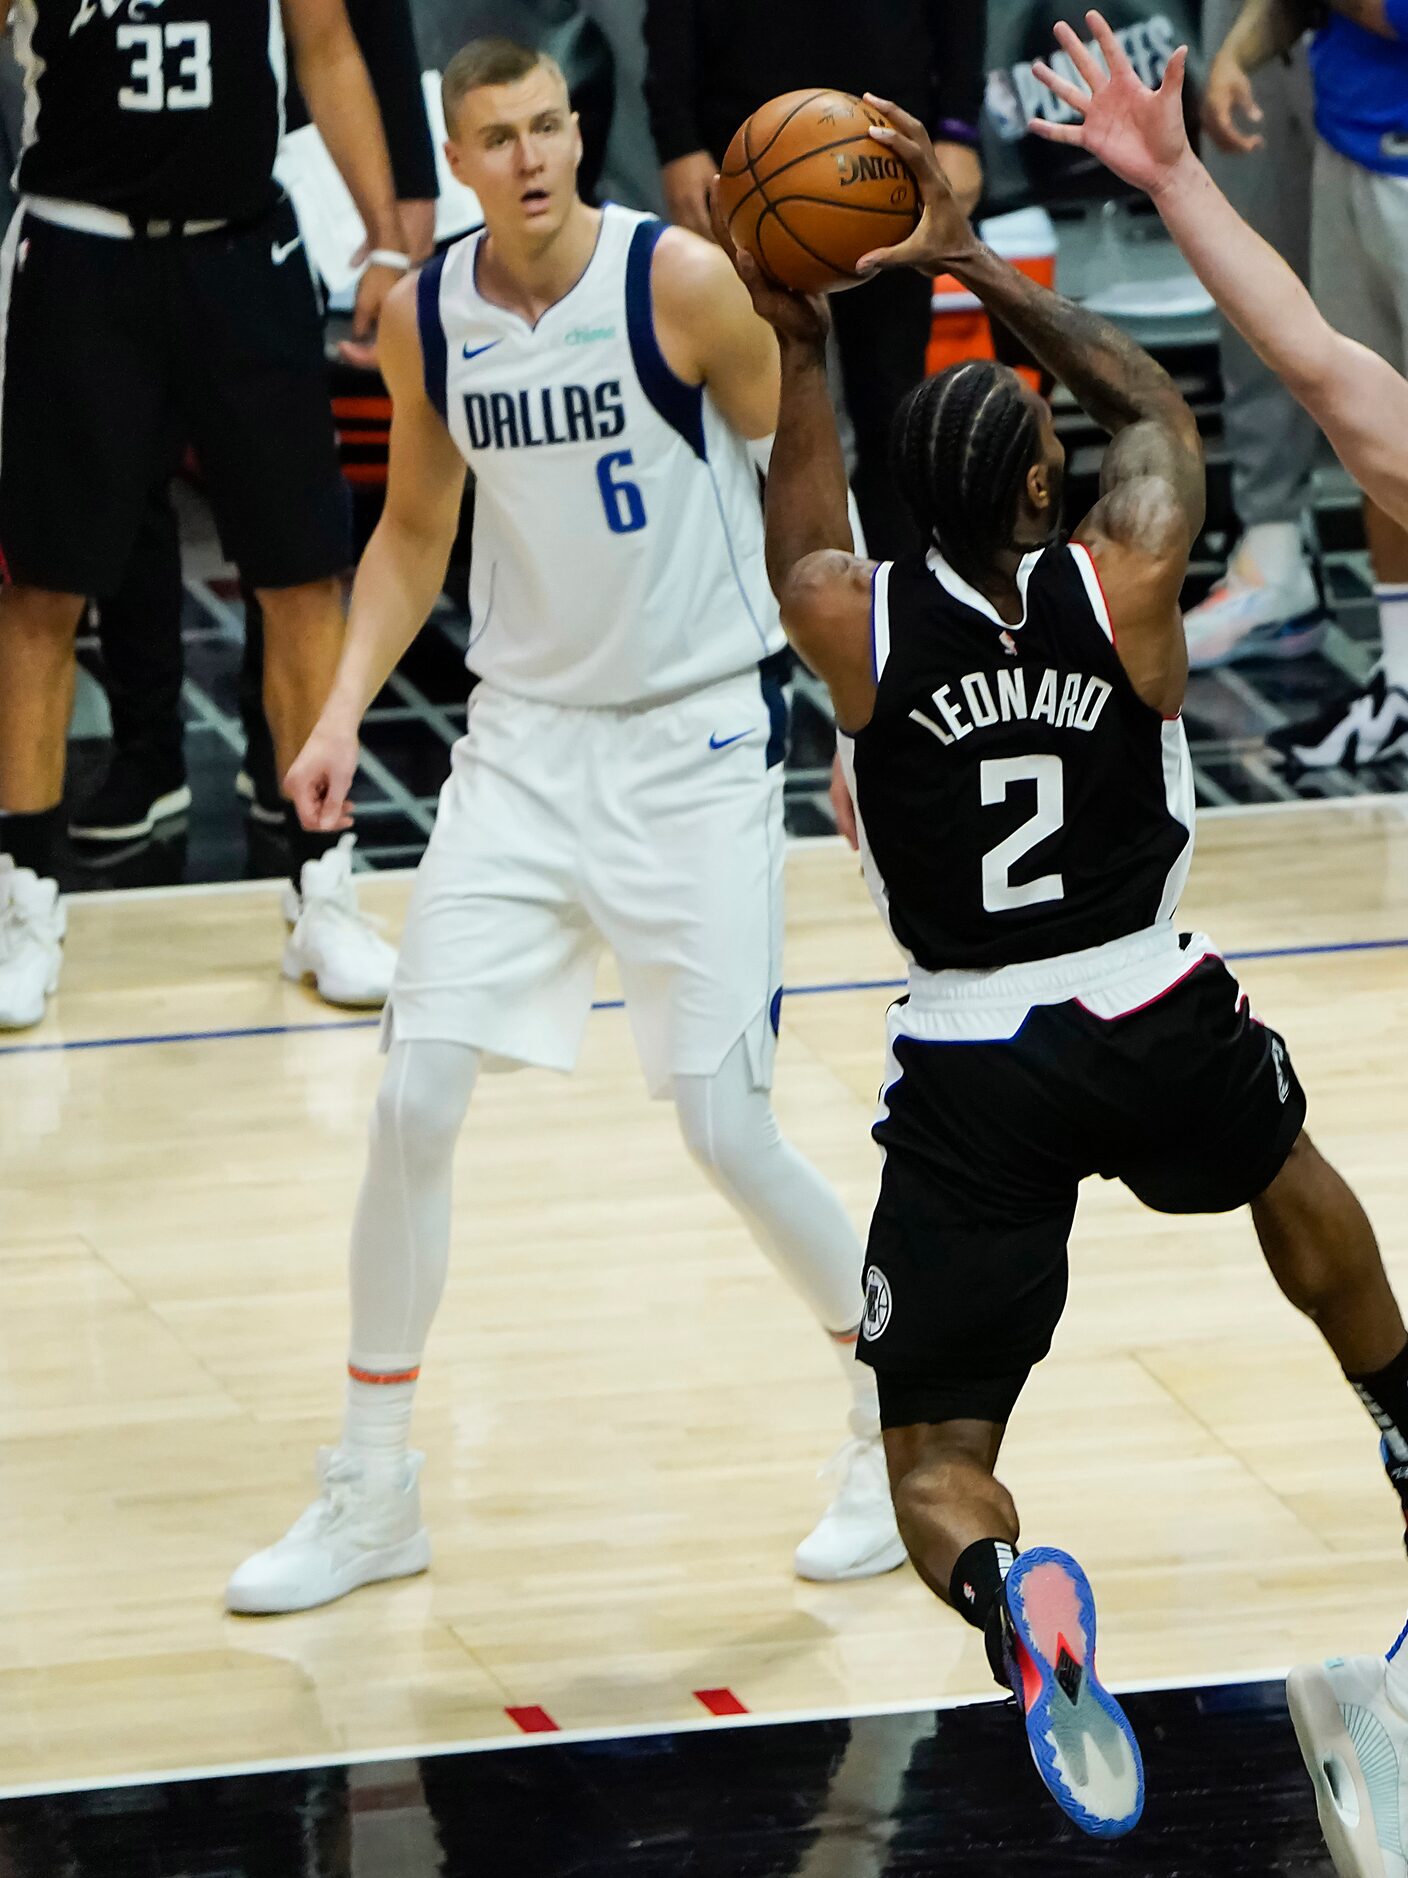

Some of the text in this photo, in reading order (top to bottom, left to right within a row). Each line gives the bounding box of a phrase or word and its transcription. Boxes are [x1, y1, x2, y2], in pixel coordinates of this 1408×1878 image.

[116, 20, 213, 112] 33
[462, 379, 626, 450] DALLAS
[595, 448, 648, 535] 6
[908, 667, 1113, 746] LEONARD
[980, 753, 1064, 913] 2
